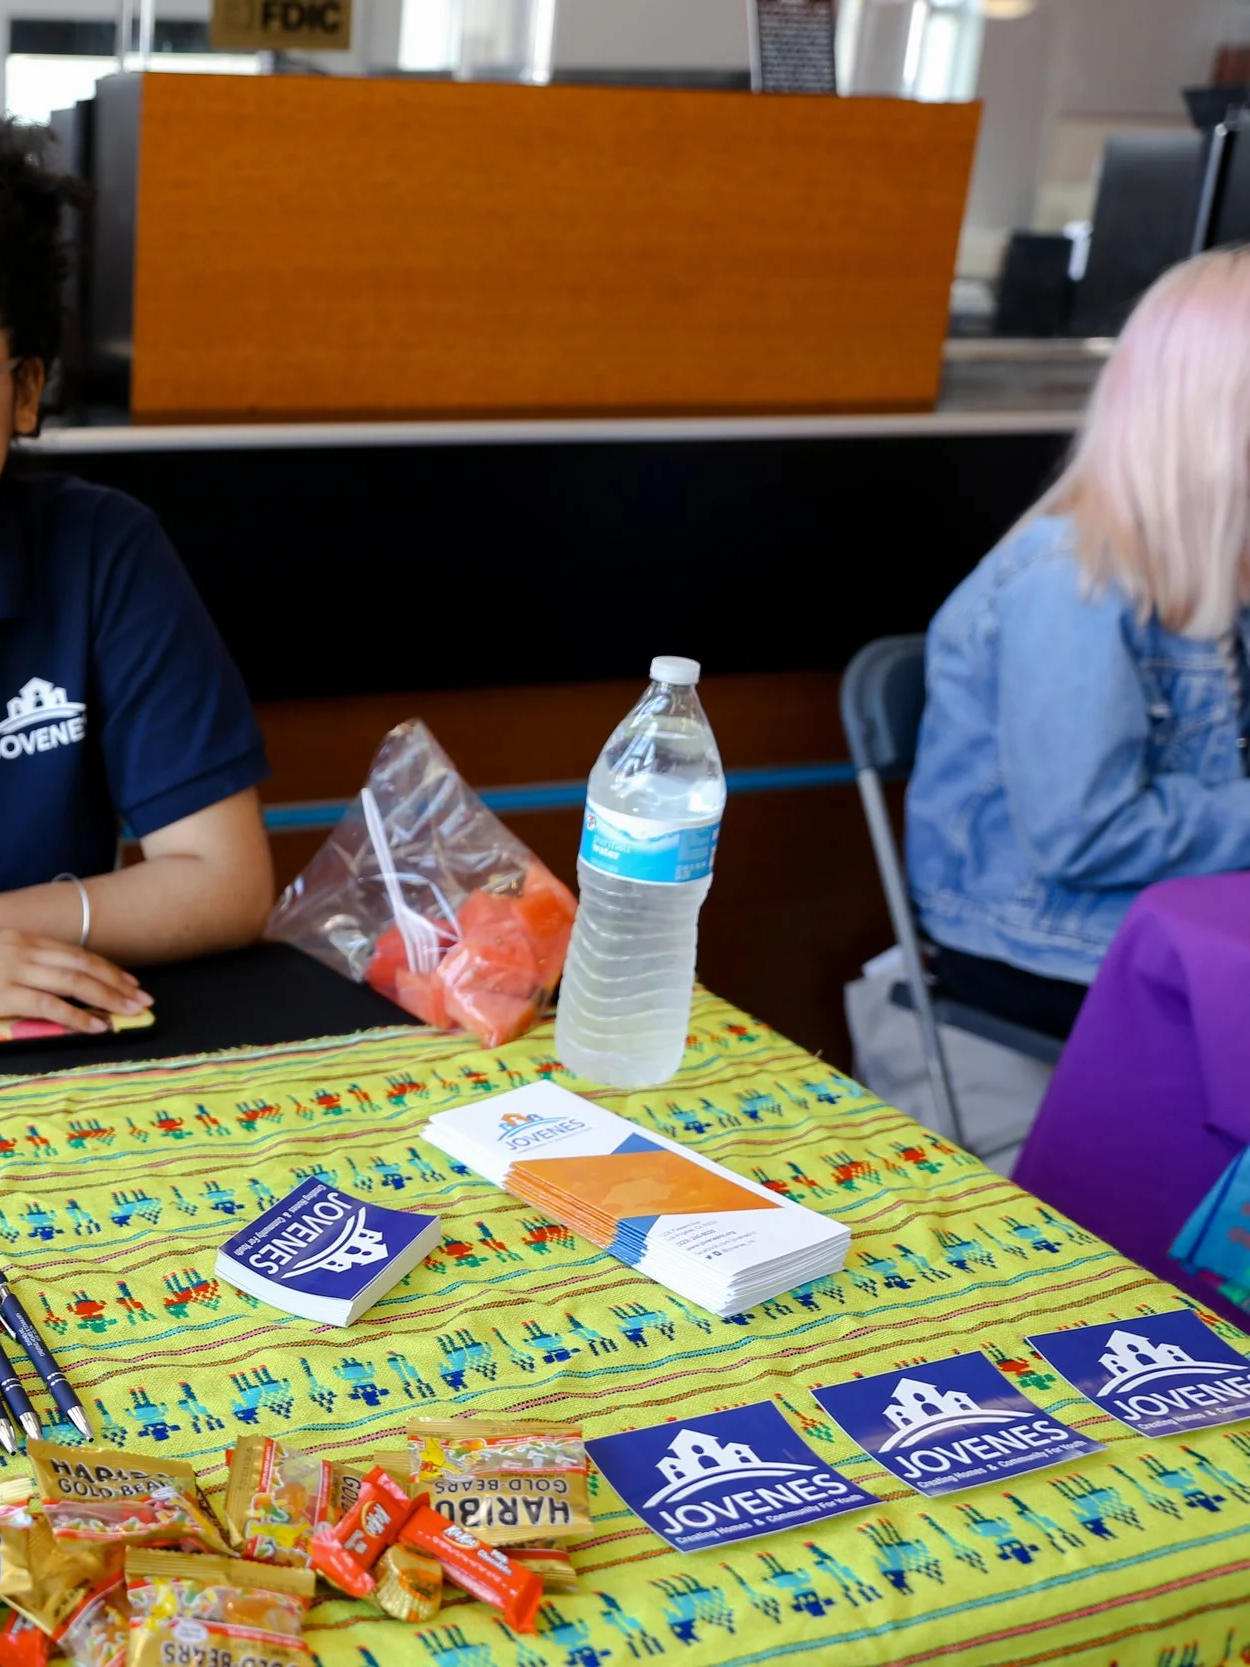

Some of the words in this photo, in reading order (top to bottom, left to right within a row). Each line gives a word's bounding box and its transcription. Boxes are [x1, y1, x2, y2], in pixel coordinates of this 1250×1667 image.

[261, 1, 341, 34] FDIC
[505, 1118, 586, 1151] JOVENES
[249, 1192, 352, 1275] JOVENES
[1113, 1375, 1250, 1421] JOVENE
[895, 1420, 1069, 1479] JOVENES
[916, 1472, 959, 1489] Creating
[956, 1467, 988, 1479] Homes
[986, 1463, 999, 1471] &
[997, 1449, 1049, 1468] Community
[1044, 1446, 1062, 1455] For
[1058, 1440, 1088, 1451] Youth
[435, 1496, 570, 1527] HARIBO
[658, 1473, 848, 1535] JOVENES
[675, 1528, 720, 1544] Creating
[717, 1521, 753, 1534] Homes
[753, 1518, 766, 1526] &
[765, 1503, 822, 1523] Community
[818, 1500, 838, 1510] For
[834, 1493, 865, 1504] Youth
